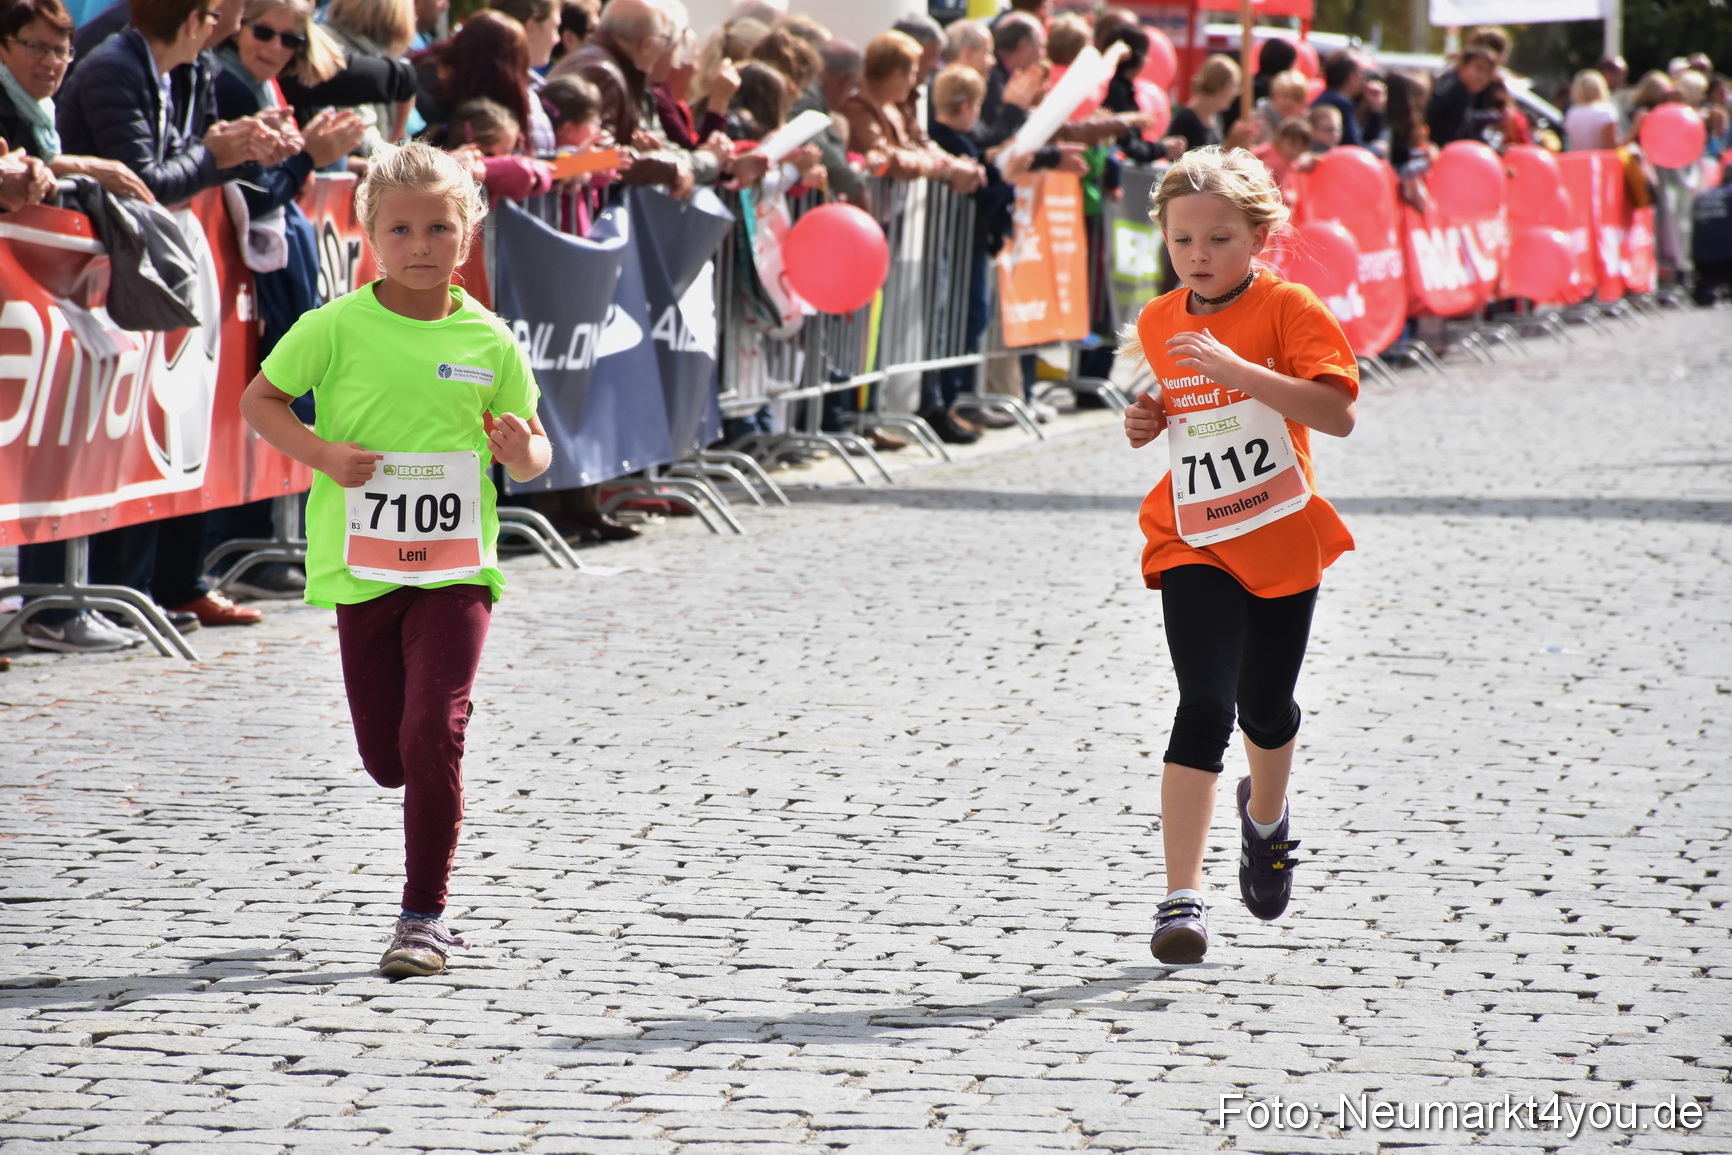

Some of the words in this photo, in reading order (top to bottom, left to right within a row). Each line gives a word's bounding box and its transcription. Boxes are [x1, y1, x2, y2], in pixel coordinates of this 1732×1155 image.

[1197, 416, 1240, 435] BOCK
[397, 464, 445, 477] BOCK
[1181, 438, 1276, 495] 7112
[365, 492, 461, 533] 7109
[1205, 491, 1269, 521] Annalena
[351, 522, 360, 530] B3
[398, 548, 427, 561] Leni
